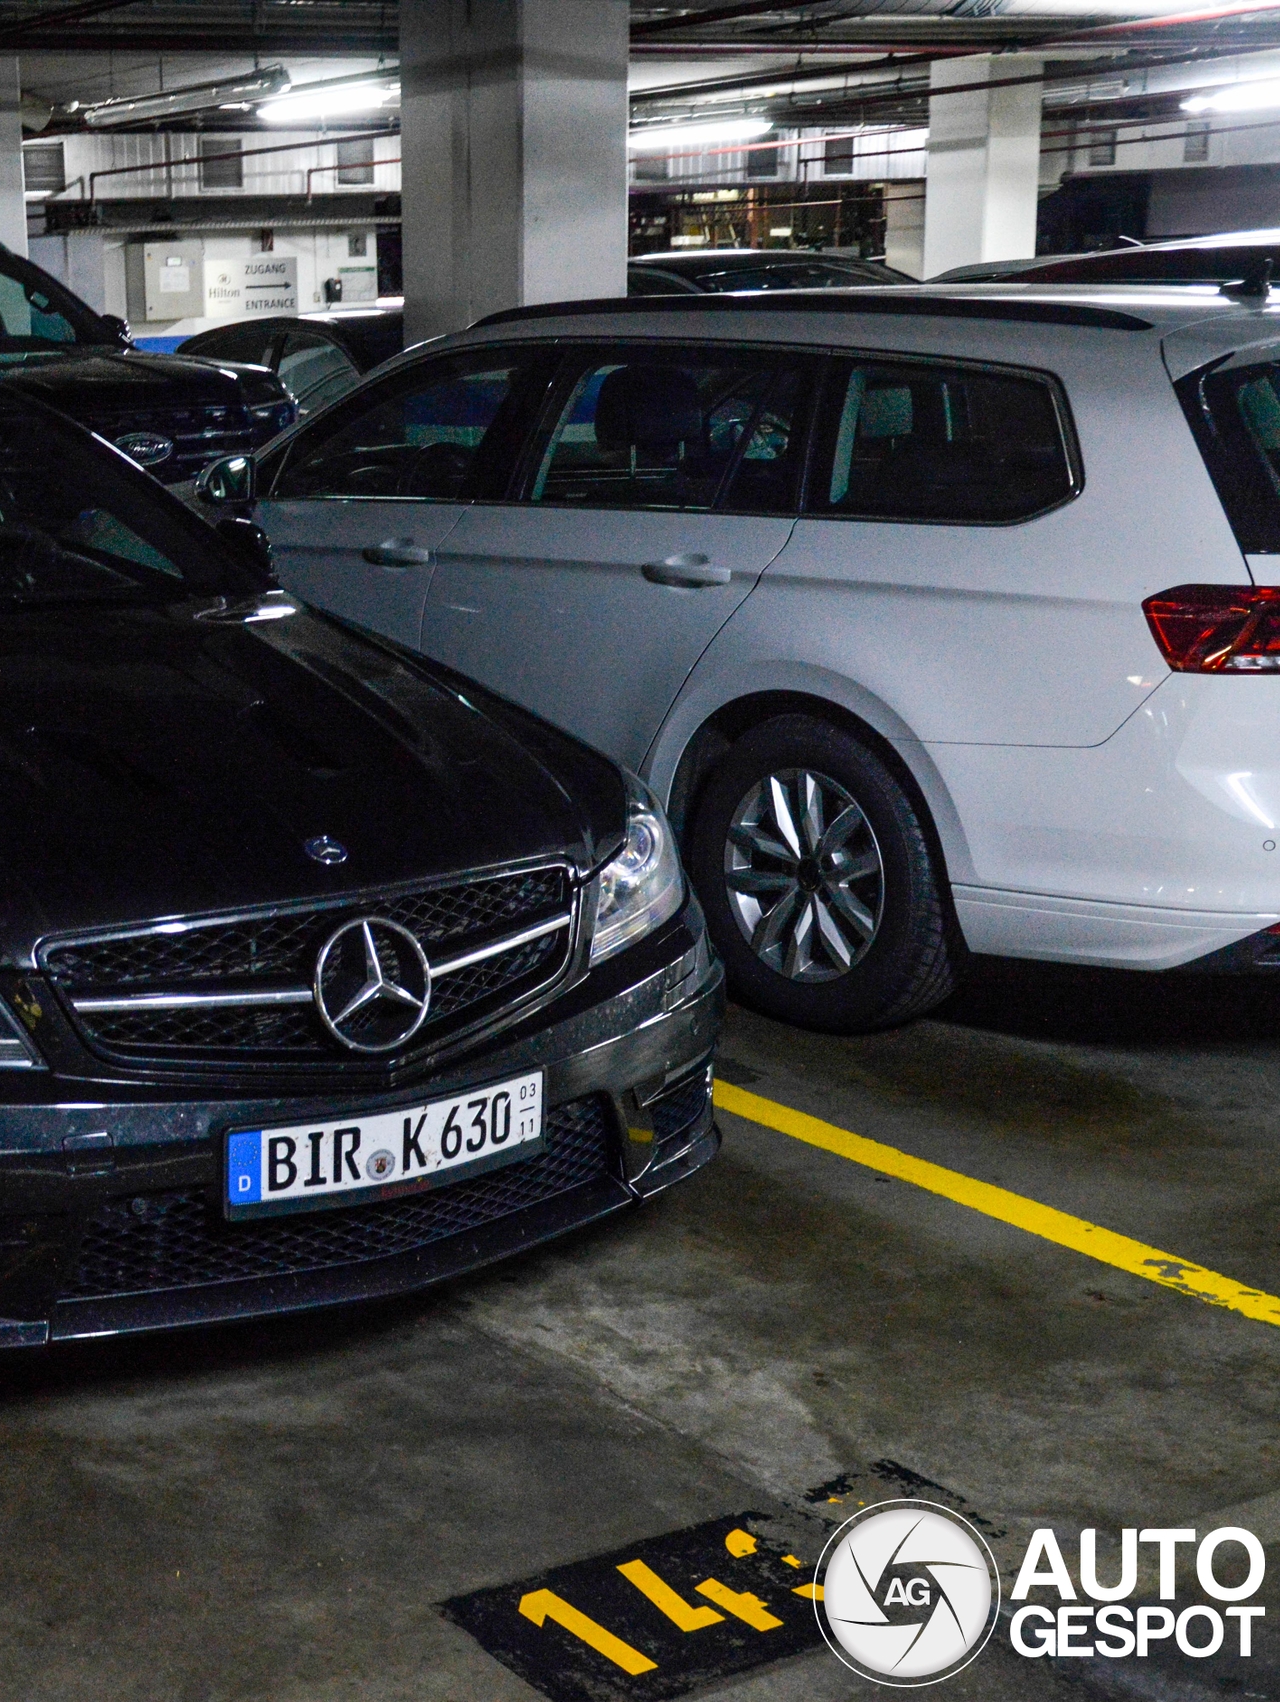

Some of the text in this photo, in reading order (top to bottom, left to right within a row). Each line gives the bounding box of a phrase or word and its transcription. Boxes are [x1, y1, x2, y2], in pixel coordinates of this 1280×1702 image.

[245, 263, 286, 275] ZUGANG
[208, 287, 240, 298] Hilton
[245, 298, 295, 310] ENTRANCE
[520, 1083, 536, 1100] 03
[520, 1118, 534, 1136] 11
[268, 1091, 511, 1192] BIR K 630
[238, 1175, 251, 1192] D
